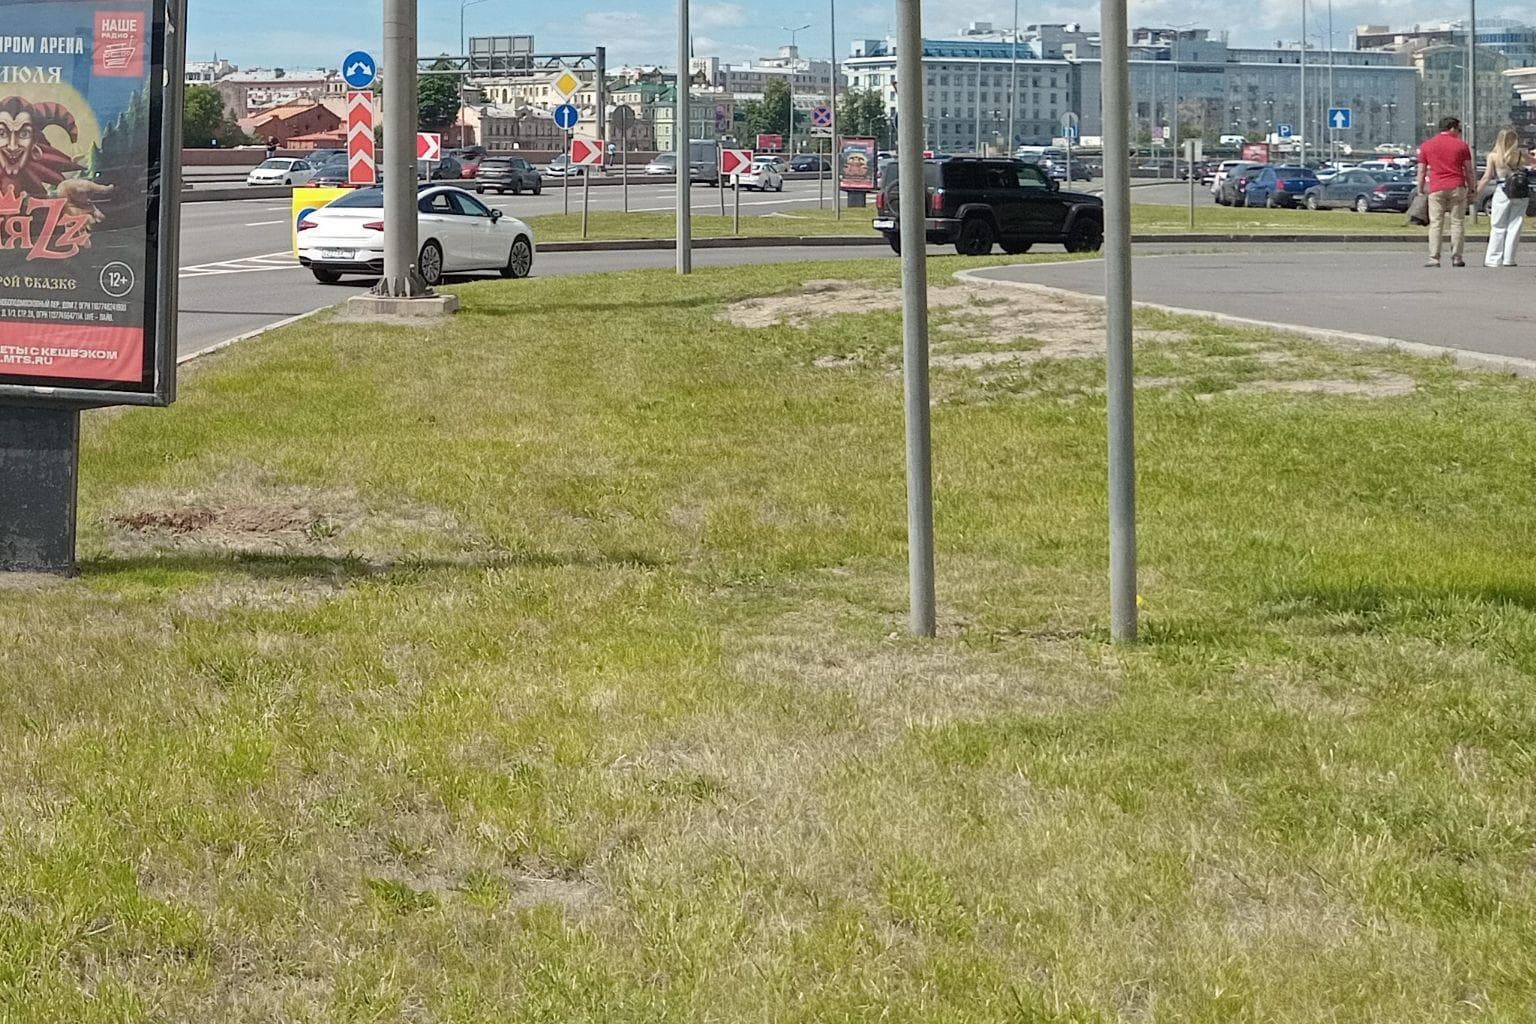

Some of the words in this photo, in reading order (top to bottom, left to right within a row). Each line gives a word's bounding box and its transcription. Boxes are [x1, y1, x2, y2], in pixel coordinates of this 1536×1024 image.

[101, 19, 137, 32] НАШЕ
[39, 36, 84, 54] АРЕНА
[24, 277, 78, 290] СКАЗКЕ
[108, 272, 128, 287] 12+
[31, 347, 40, 356] С
[41, 347, 118, 360] КЕШБЭКОМ
